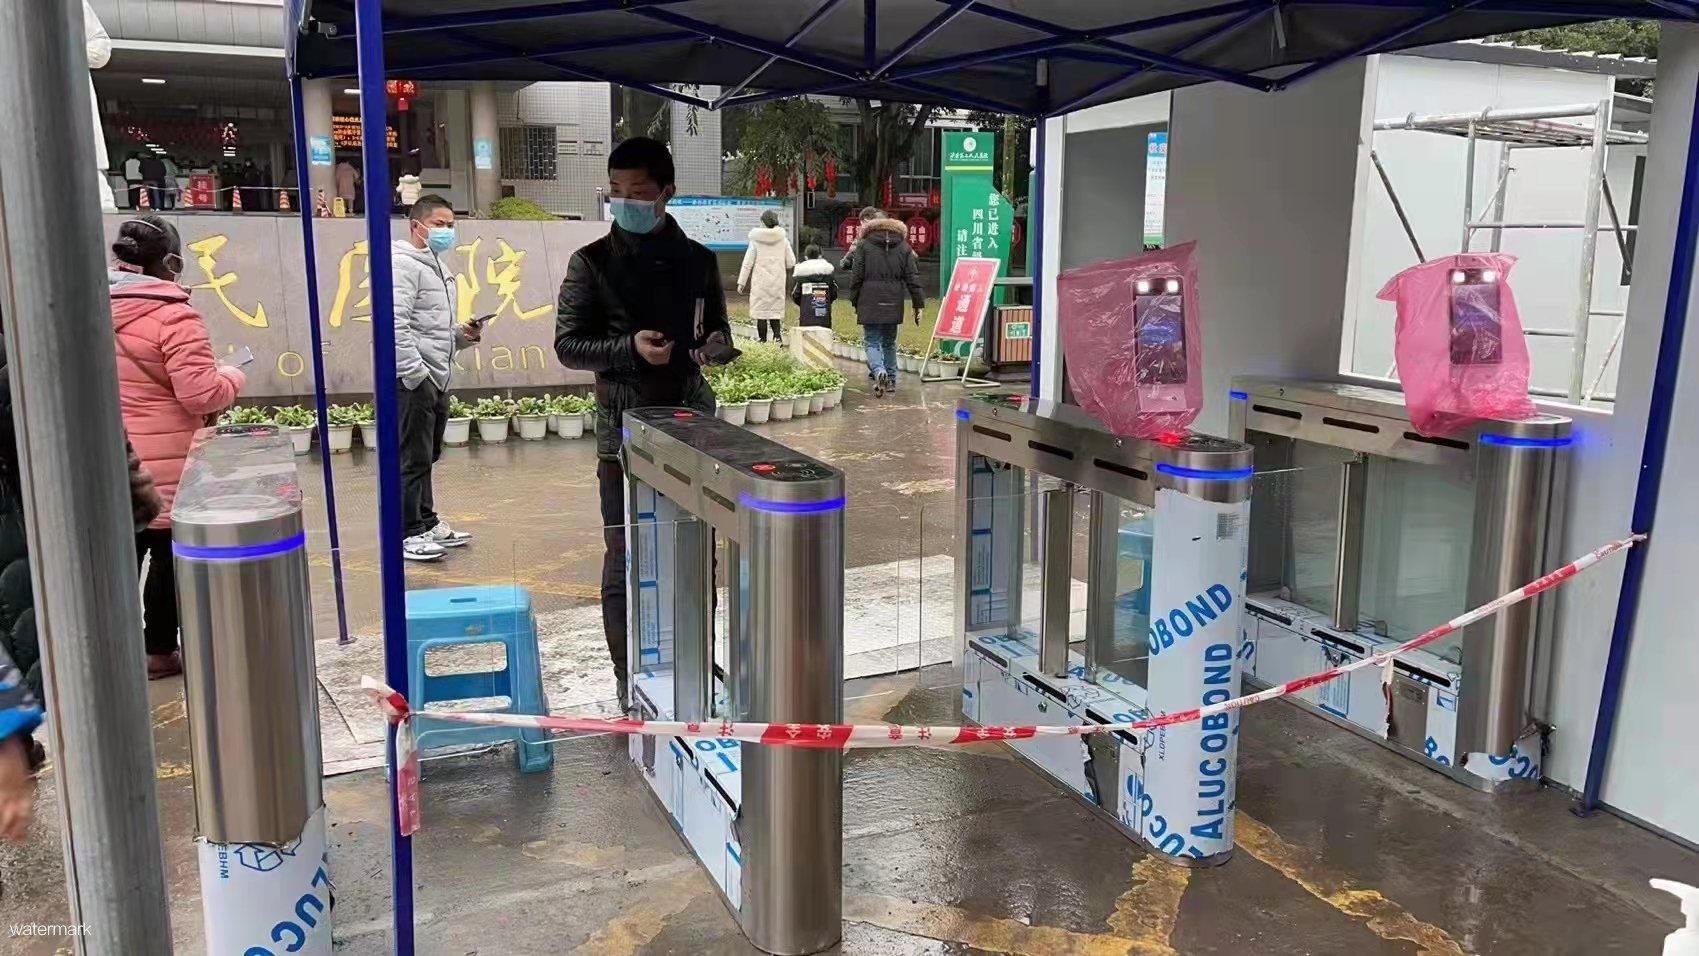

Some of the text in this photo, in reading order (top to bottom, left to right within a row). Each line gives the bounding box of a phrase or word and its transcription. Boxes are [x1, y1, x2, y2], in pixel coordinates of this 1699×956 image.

[988, 192, 1000, 250] 您已进入
[1190, 643, 1233, 840] ALUCOBOND
